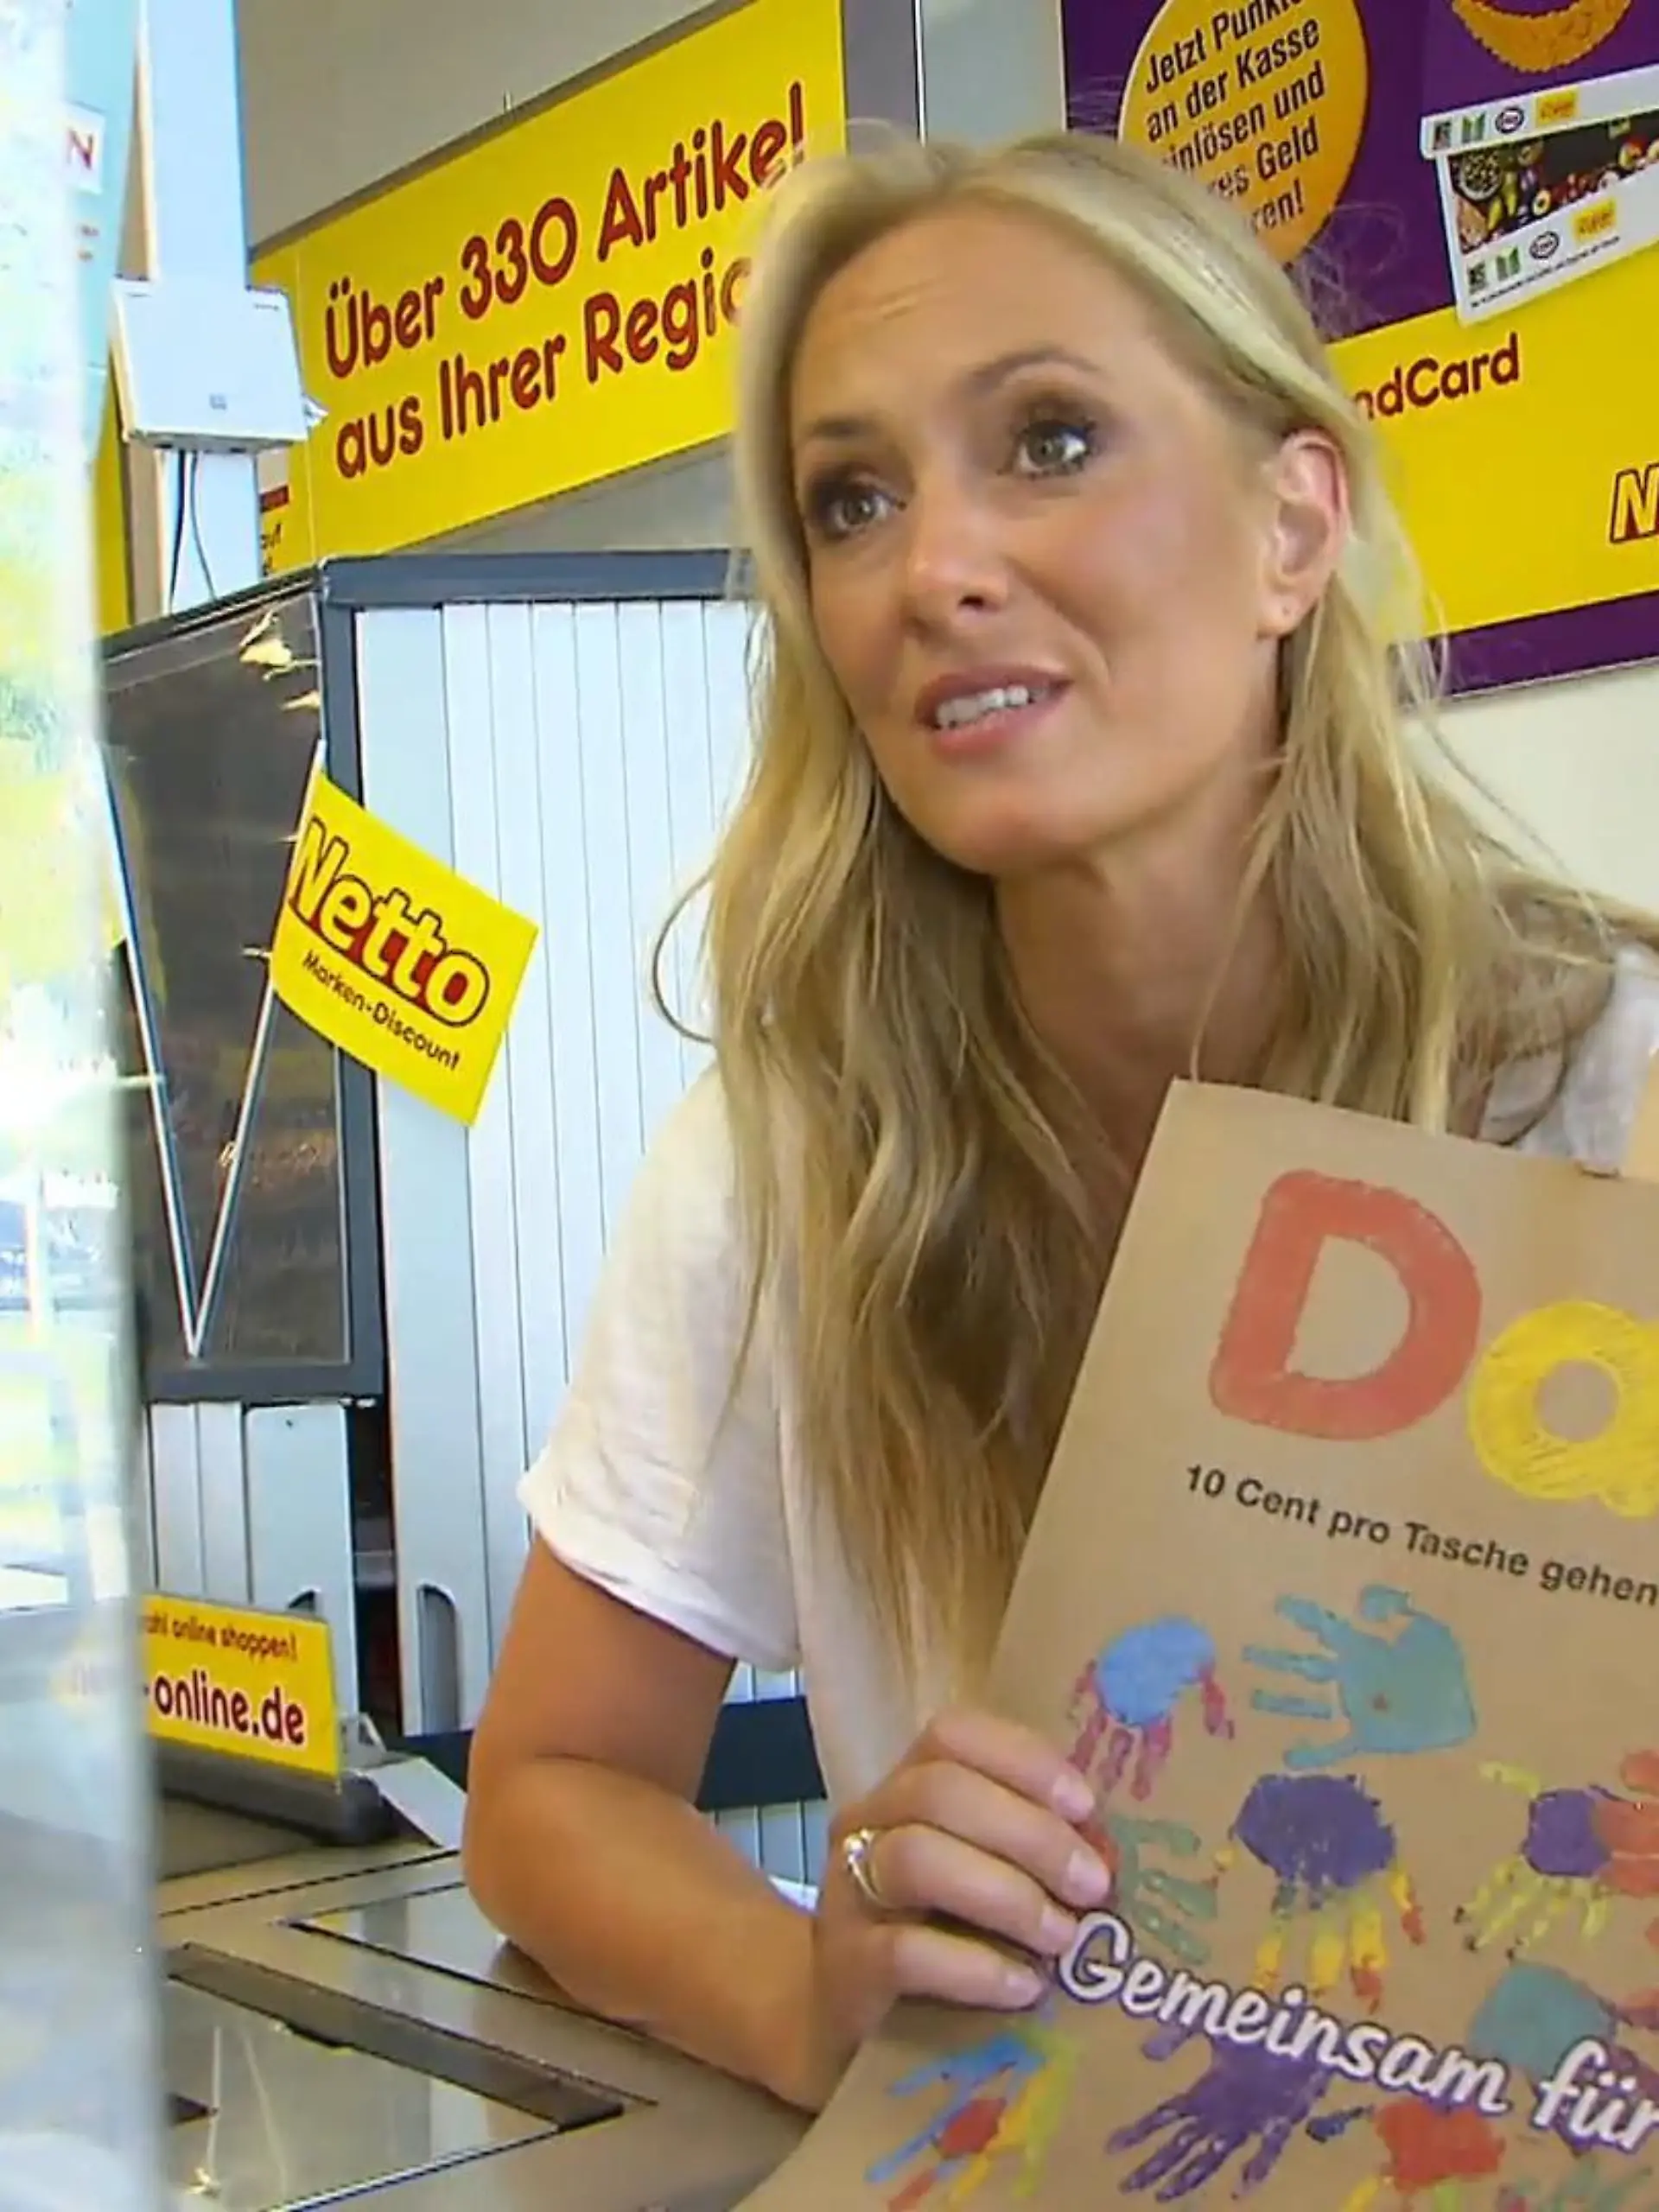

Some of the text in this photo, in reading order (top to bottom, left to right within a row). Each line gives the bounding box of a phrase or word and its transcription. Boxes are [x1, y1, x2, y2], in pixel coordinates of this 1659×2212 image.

[1145, 0, 1301, 94] Jetzt Punk
[1147, 18, 1321, 143] an der Kasse
[1163, 60, 1325, 170] inlösen und
[1256, 116, 1319, 181] Geld
[325, 80, 804, 378] Über 330 Artikel
[335, 245, 751, 479] aus Ihrer Regio
[1353, 332, 1520, 422] ndCard
[1609, 461, 1659, 543] N
[288, 816, 491, 1027] Netto
[1185, 1464, 1659, 1606] 10 Cent pro Tasche gehen
[173, 1615, 216, 1648] online
[221, 1625, 297, 1662] shoppen!
[1056, 1910, 1513, 2117] Gemeinsam
